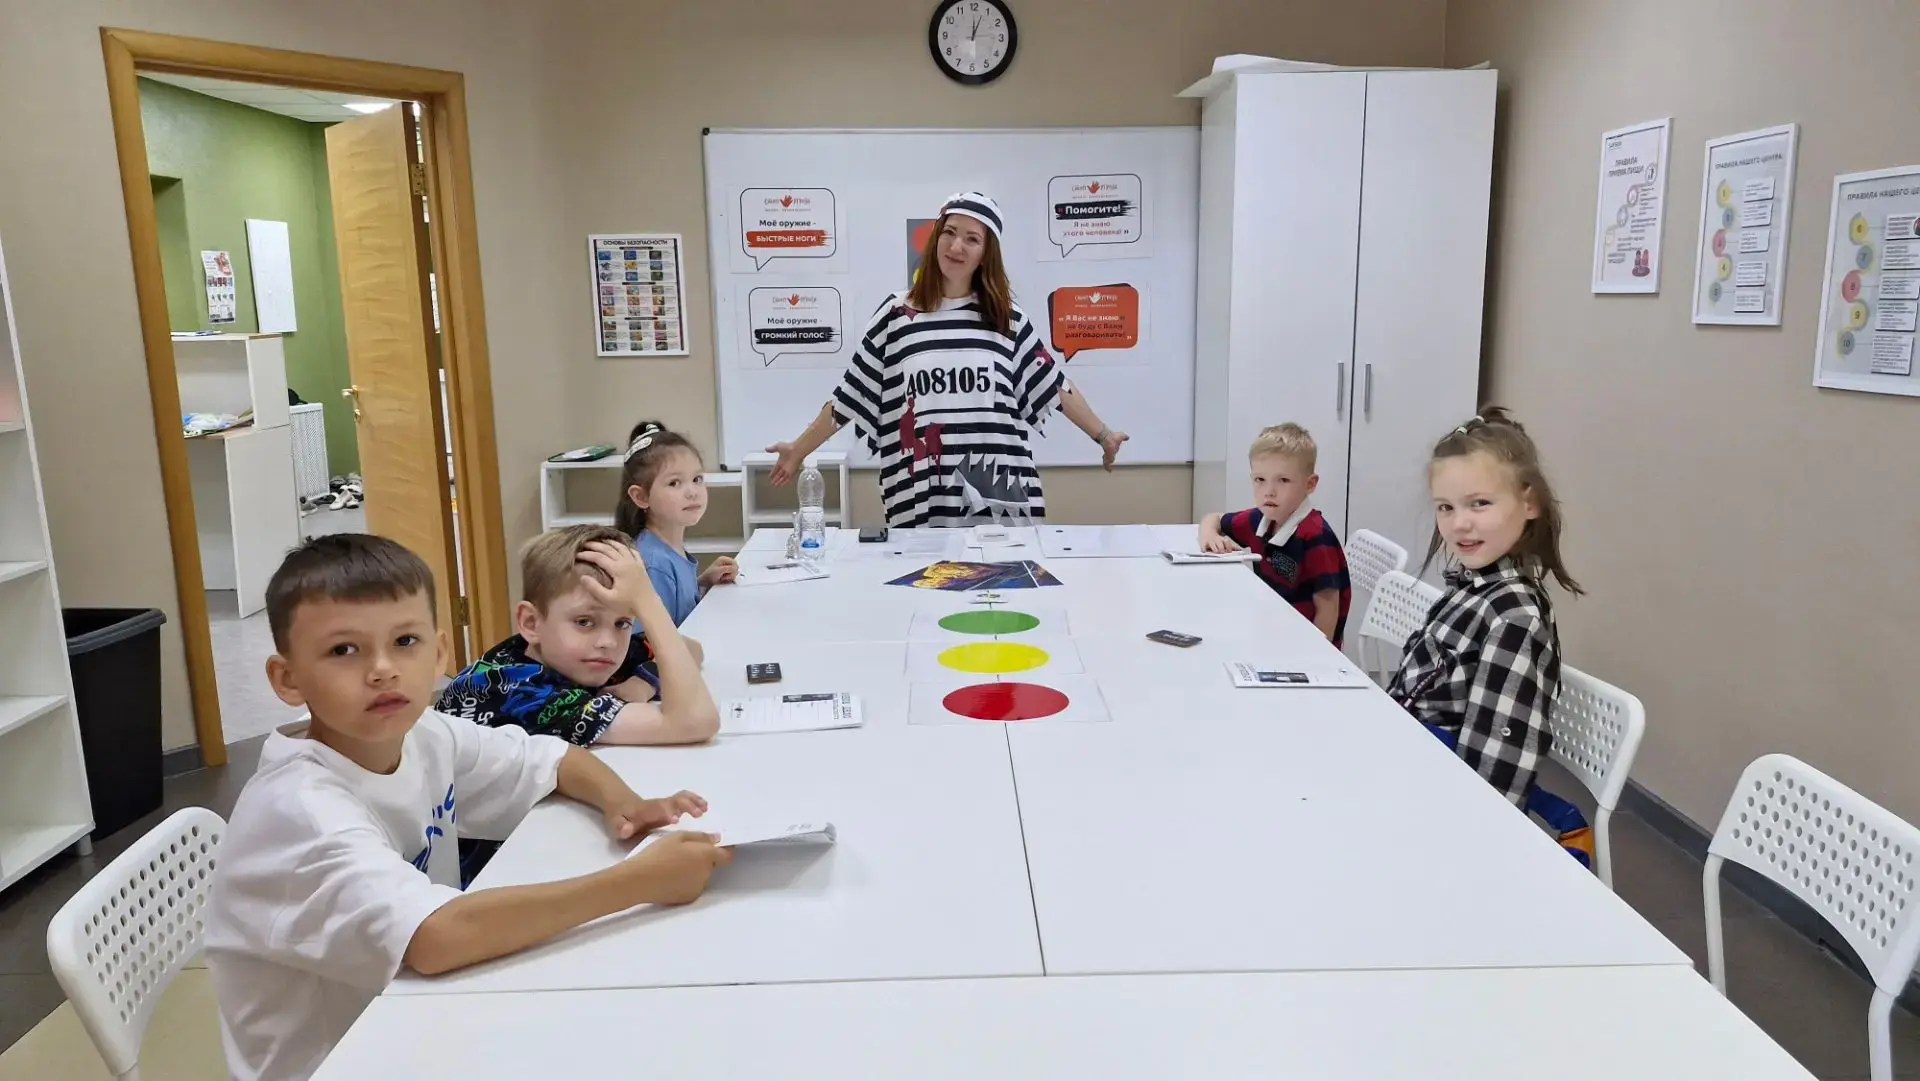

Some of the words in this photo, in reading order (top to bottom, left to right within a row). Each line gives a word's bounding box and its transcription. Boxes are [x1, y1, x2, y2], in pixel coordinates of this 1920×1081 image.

[956, 5, 964, 15] 11
[970, 3, 979, 11] 12
[985, 7, 990, 16] 1
[945, 16, 955, 24] 10
[994, 18, 1001, 27] 2
[942, 31, 948, 40] 9
[998, 33, 1004, 42] 3
[946, 47, 952, 56] 8
[993, 49, 999, 57] 4
[956, 58, 961, 67] 7
[969, 63, 975, 71] 6
[983, 59, 989, 68] 5
[1847, 190, 1878, 200] ПРАВИЛА
[1879, 187, 1909, 198] НАШЕГО
[1065, 204, 1121, 215] Помогите!
[759, 219, 777, 227] Моё
[779, 220, 811, 228] оружие
[761, 331, 797, 339] ГРОМКИЙ
[906, 367, 991, 399] 408105
